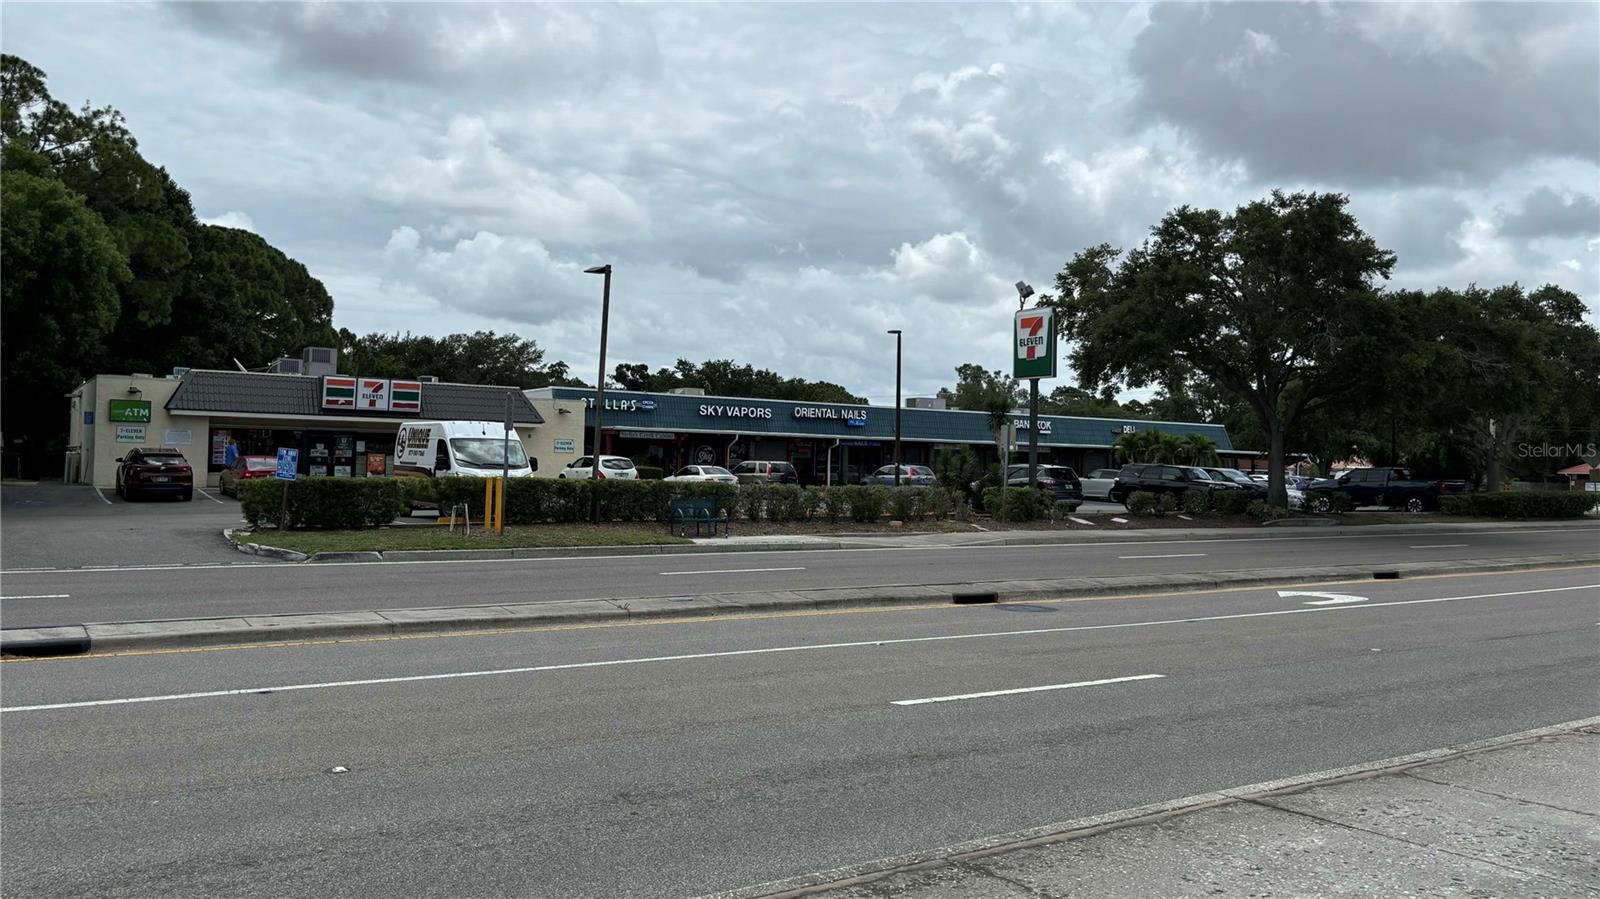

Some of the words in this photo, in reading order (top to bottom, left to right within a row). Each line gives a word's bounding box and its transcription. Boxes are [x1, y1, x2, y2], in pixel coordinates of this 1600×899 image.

[1020, 316, 1043, 360] 7
[581, 397, 637, 412] STLLA'S
[124, 407, 149, 417] ATM
[699, 405, 723, 416] SKY
[726, 406, 772, 419] VAPORS
[794, 407, 838, 419] ORIENTAL
[841, 409, 867, 420] NAILS
[1013, 419, 1052, 431] BANKOK
[1123, 425, 1136, 434] DELI
